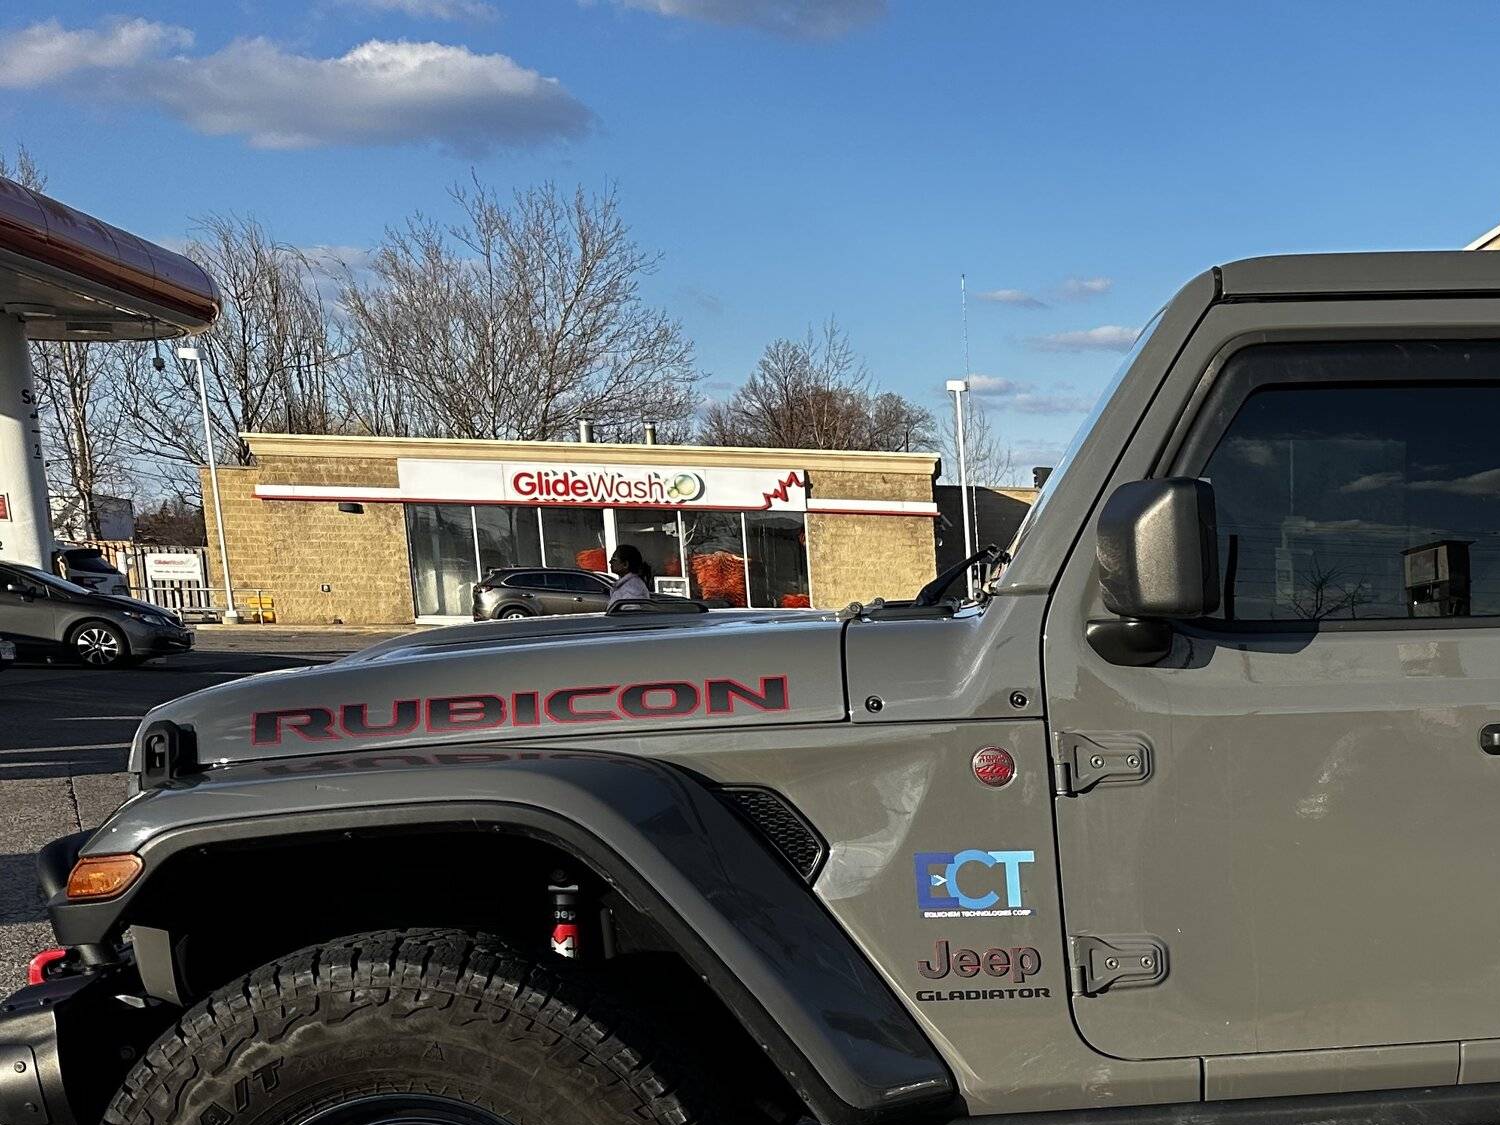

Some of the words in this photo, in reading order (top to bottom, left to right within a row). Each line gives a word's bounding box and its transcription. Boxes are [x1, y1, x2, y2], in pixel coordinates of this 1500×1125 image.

[513, 471, 664, 499] GlideWash
[251, 674, 790, 747] RUBICON
[914, 849, 1036, 910] ECT
[961, 909, 1012, 918] TECHNOLOGIES
[1012, 908, 1032, 917] CORP
[916, 938, 1042, 984] Jeep
[916, 987, 1052, 1002] GLADIATOR
